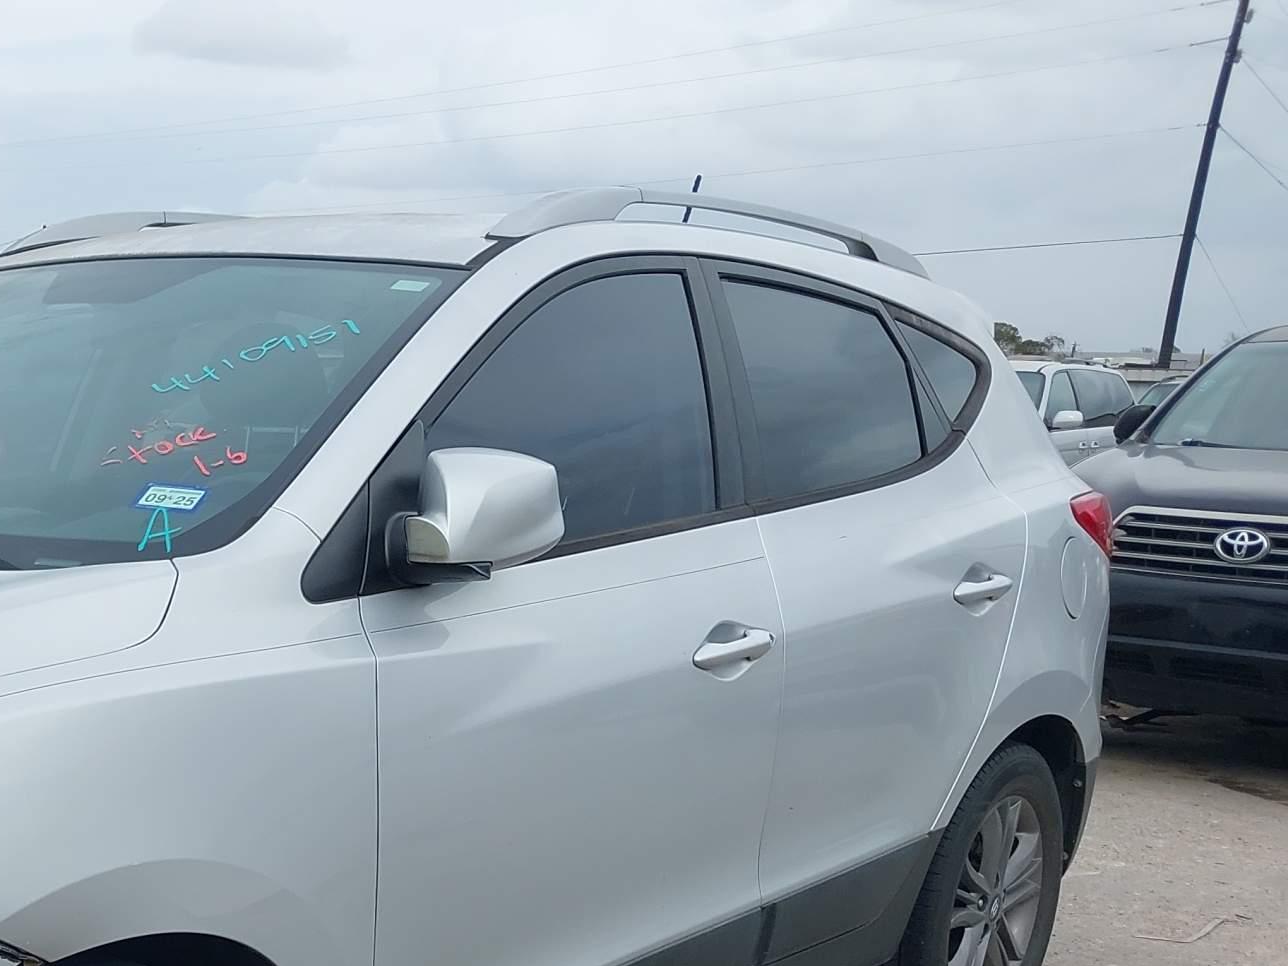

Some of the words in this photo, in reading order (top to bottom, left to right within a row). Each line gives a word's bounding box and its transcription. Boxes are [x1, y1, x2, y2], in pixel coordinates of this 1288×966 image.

[151, 319, 361, 393] 44109151
[144, 492, 168, 504] 09
[172, 495, 198, 507] 25
[137, 507, 183, 553] A
